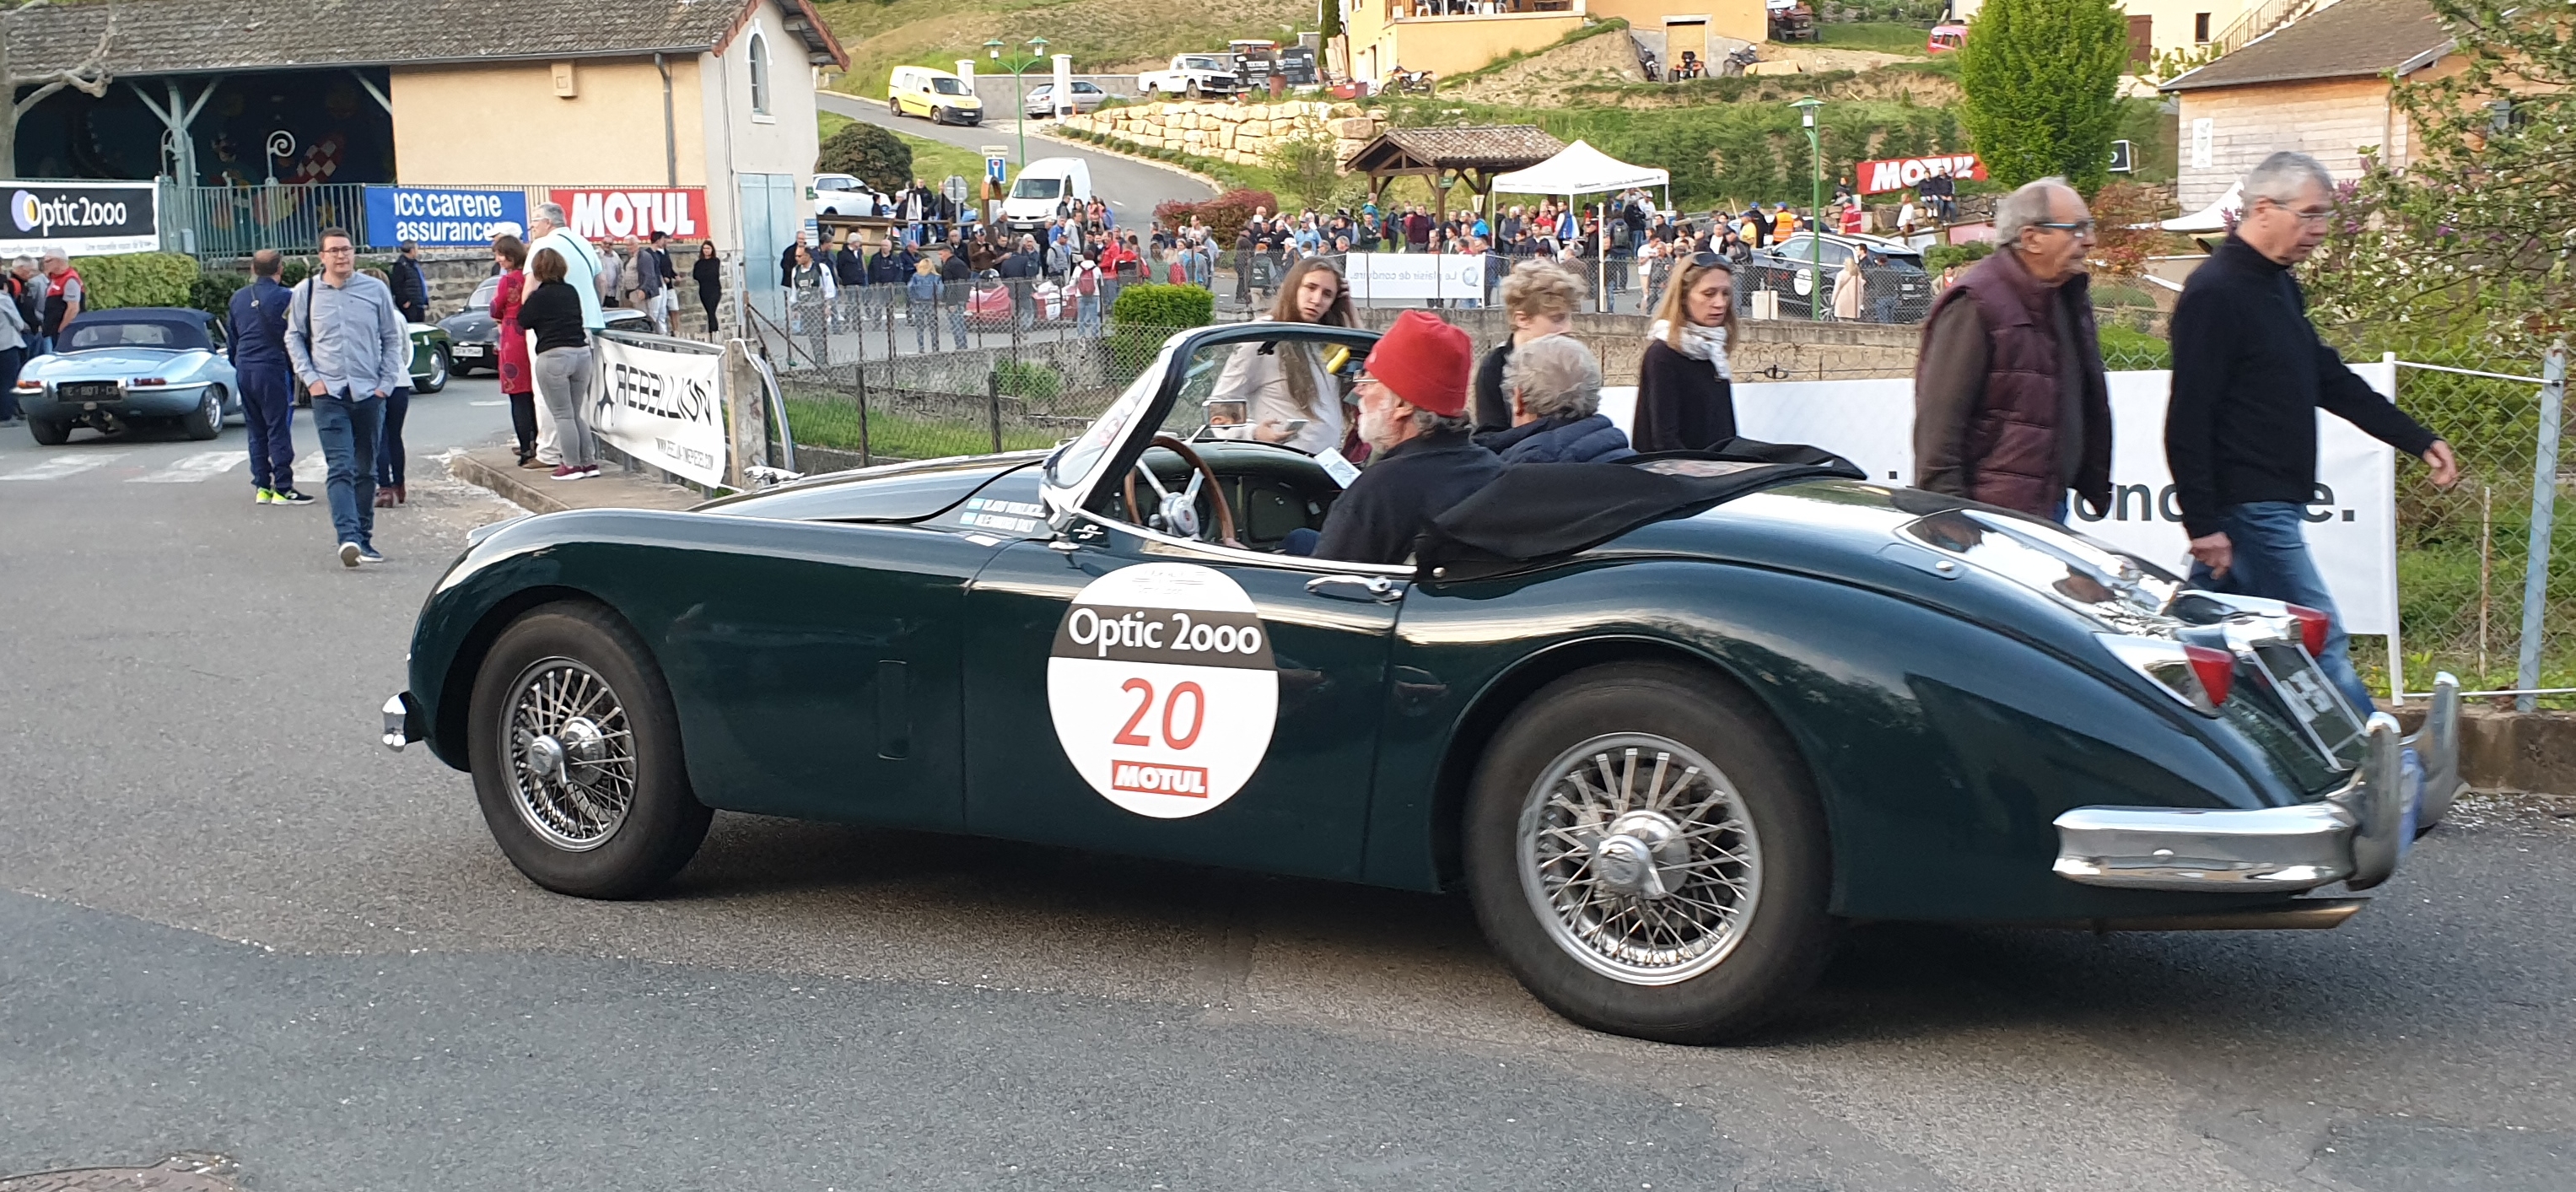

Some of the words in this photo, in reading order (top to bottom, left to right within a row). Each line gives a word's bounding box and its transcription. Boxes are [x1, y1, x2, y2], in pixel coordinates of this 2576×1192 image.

[1870, 156, 1975, 191] MOTUL
[394, 192, 425, 217] ICC
[426, 193, 503, 217] carene
[570, 192, 695, 237] MOTUL
[396, 221, 504, 241] assurance
[1068, 607, 1164, 657] Optic
[1170, 612, 1263, 655] 2000
[1113, 677, 1205, 750] 20
[1113, 764, 1206, 794] MOTUL
